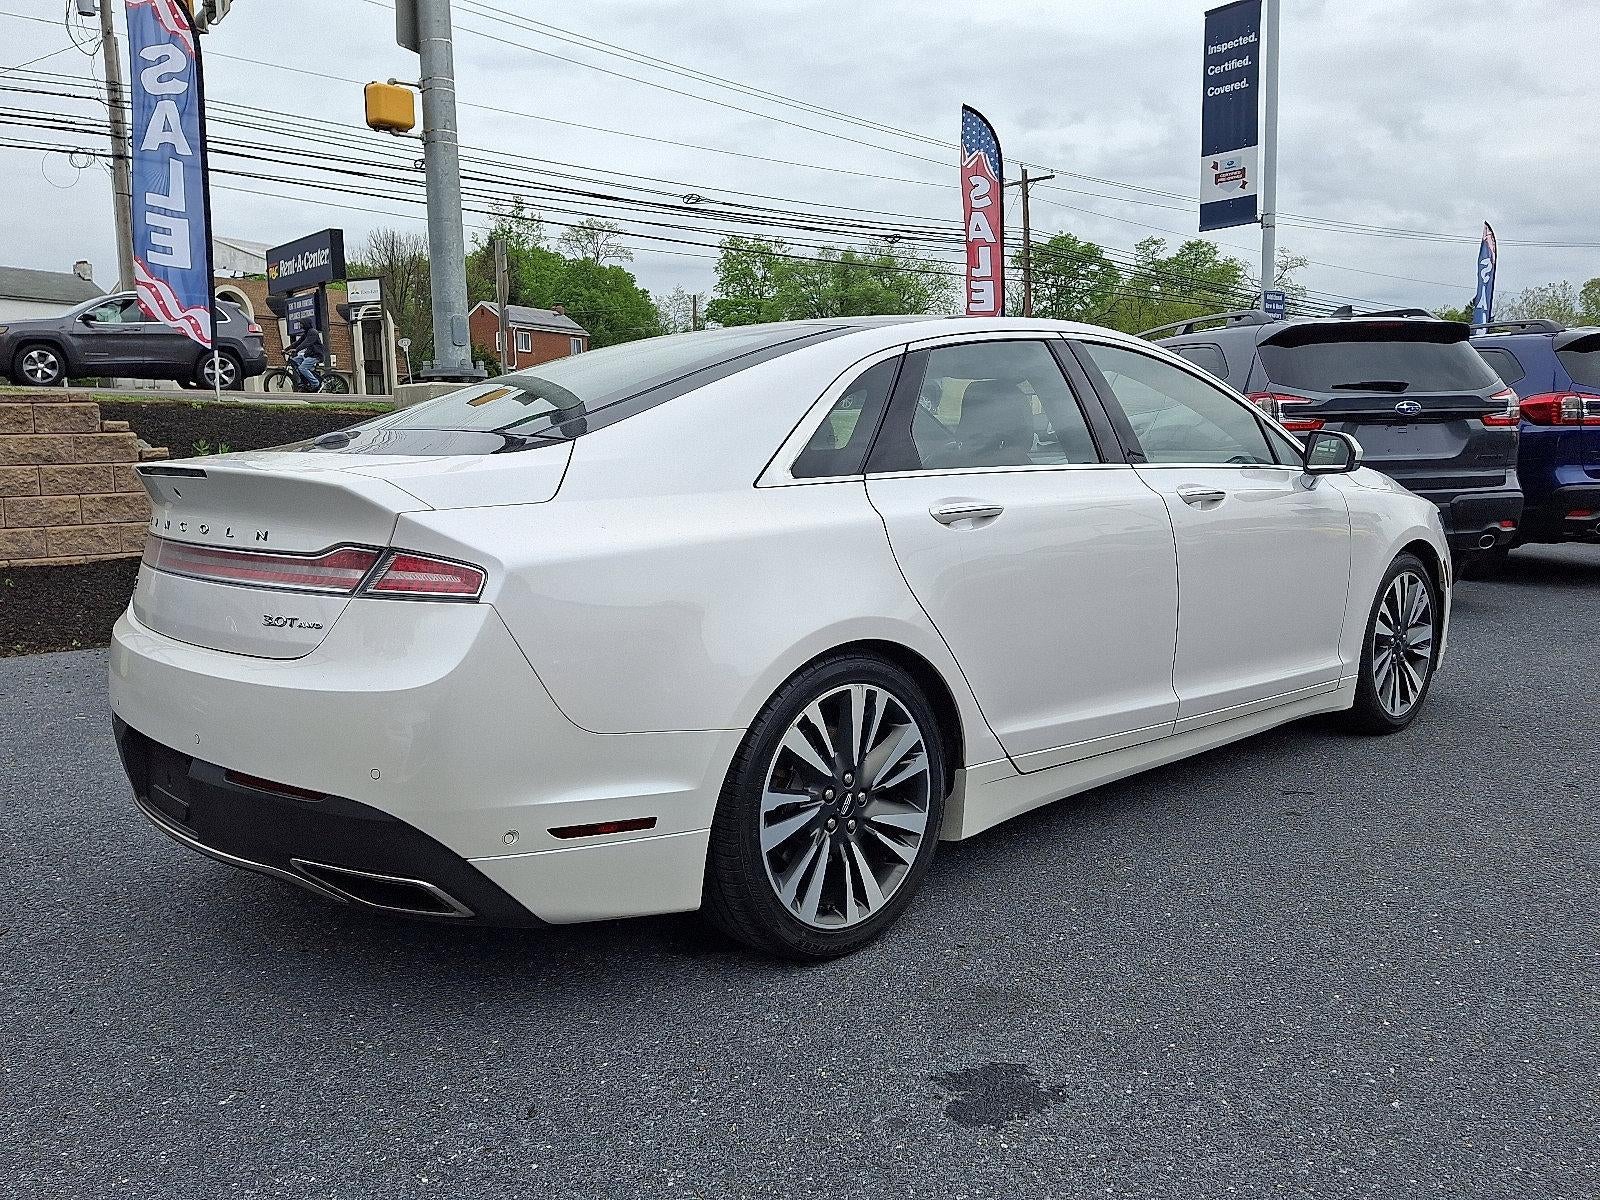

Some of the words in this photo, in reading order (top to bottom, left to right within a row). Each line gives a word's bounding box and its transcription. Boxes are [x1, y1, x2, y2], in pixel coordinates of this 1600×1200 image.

[1207, 31, 1258, 55] Inspected.
[1207, 55, 1252, 76] Certified.
[1207, 78, 1249, 97] Covered.
